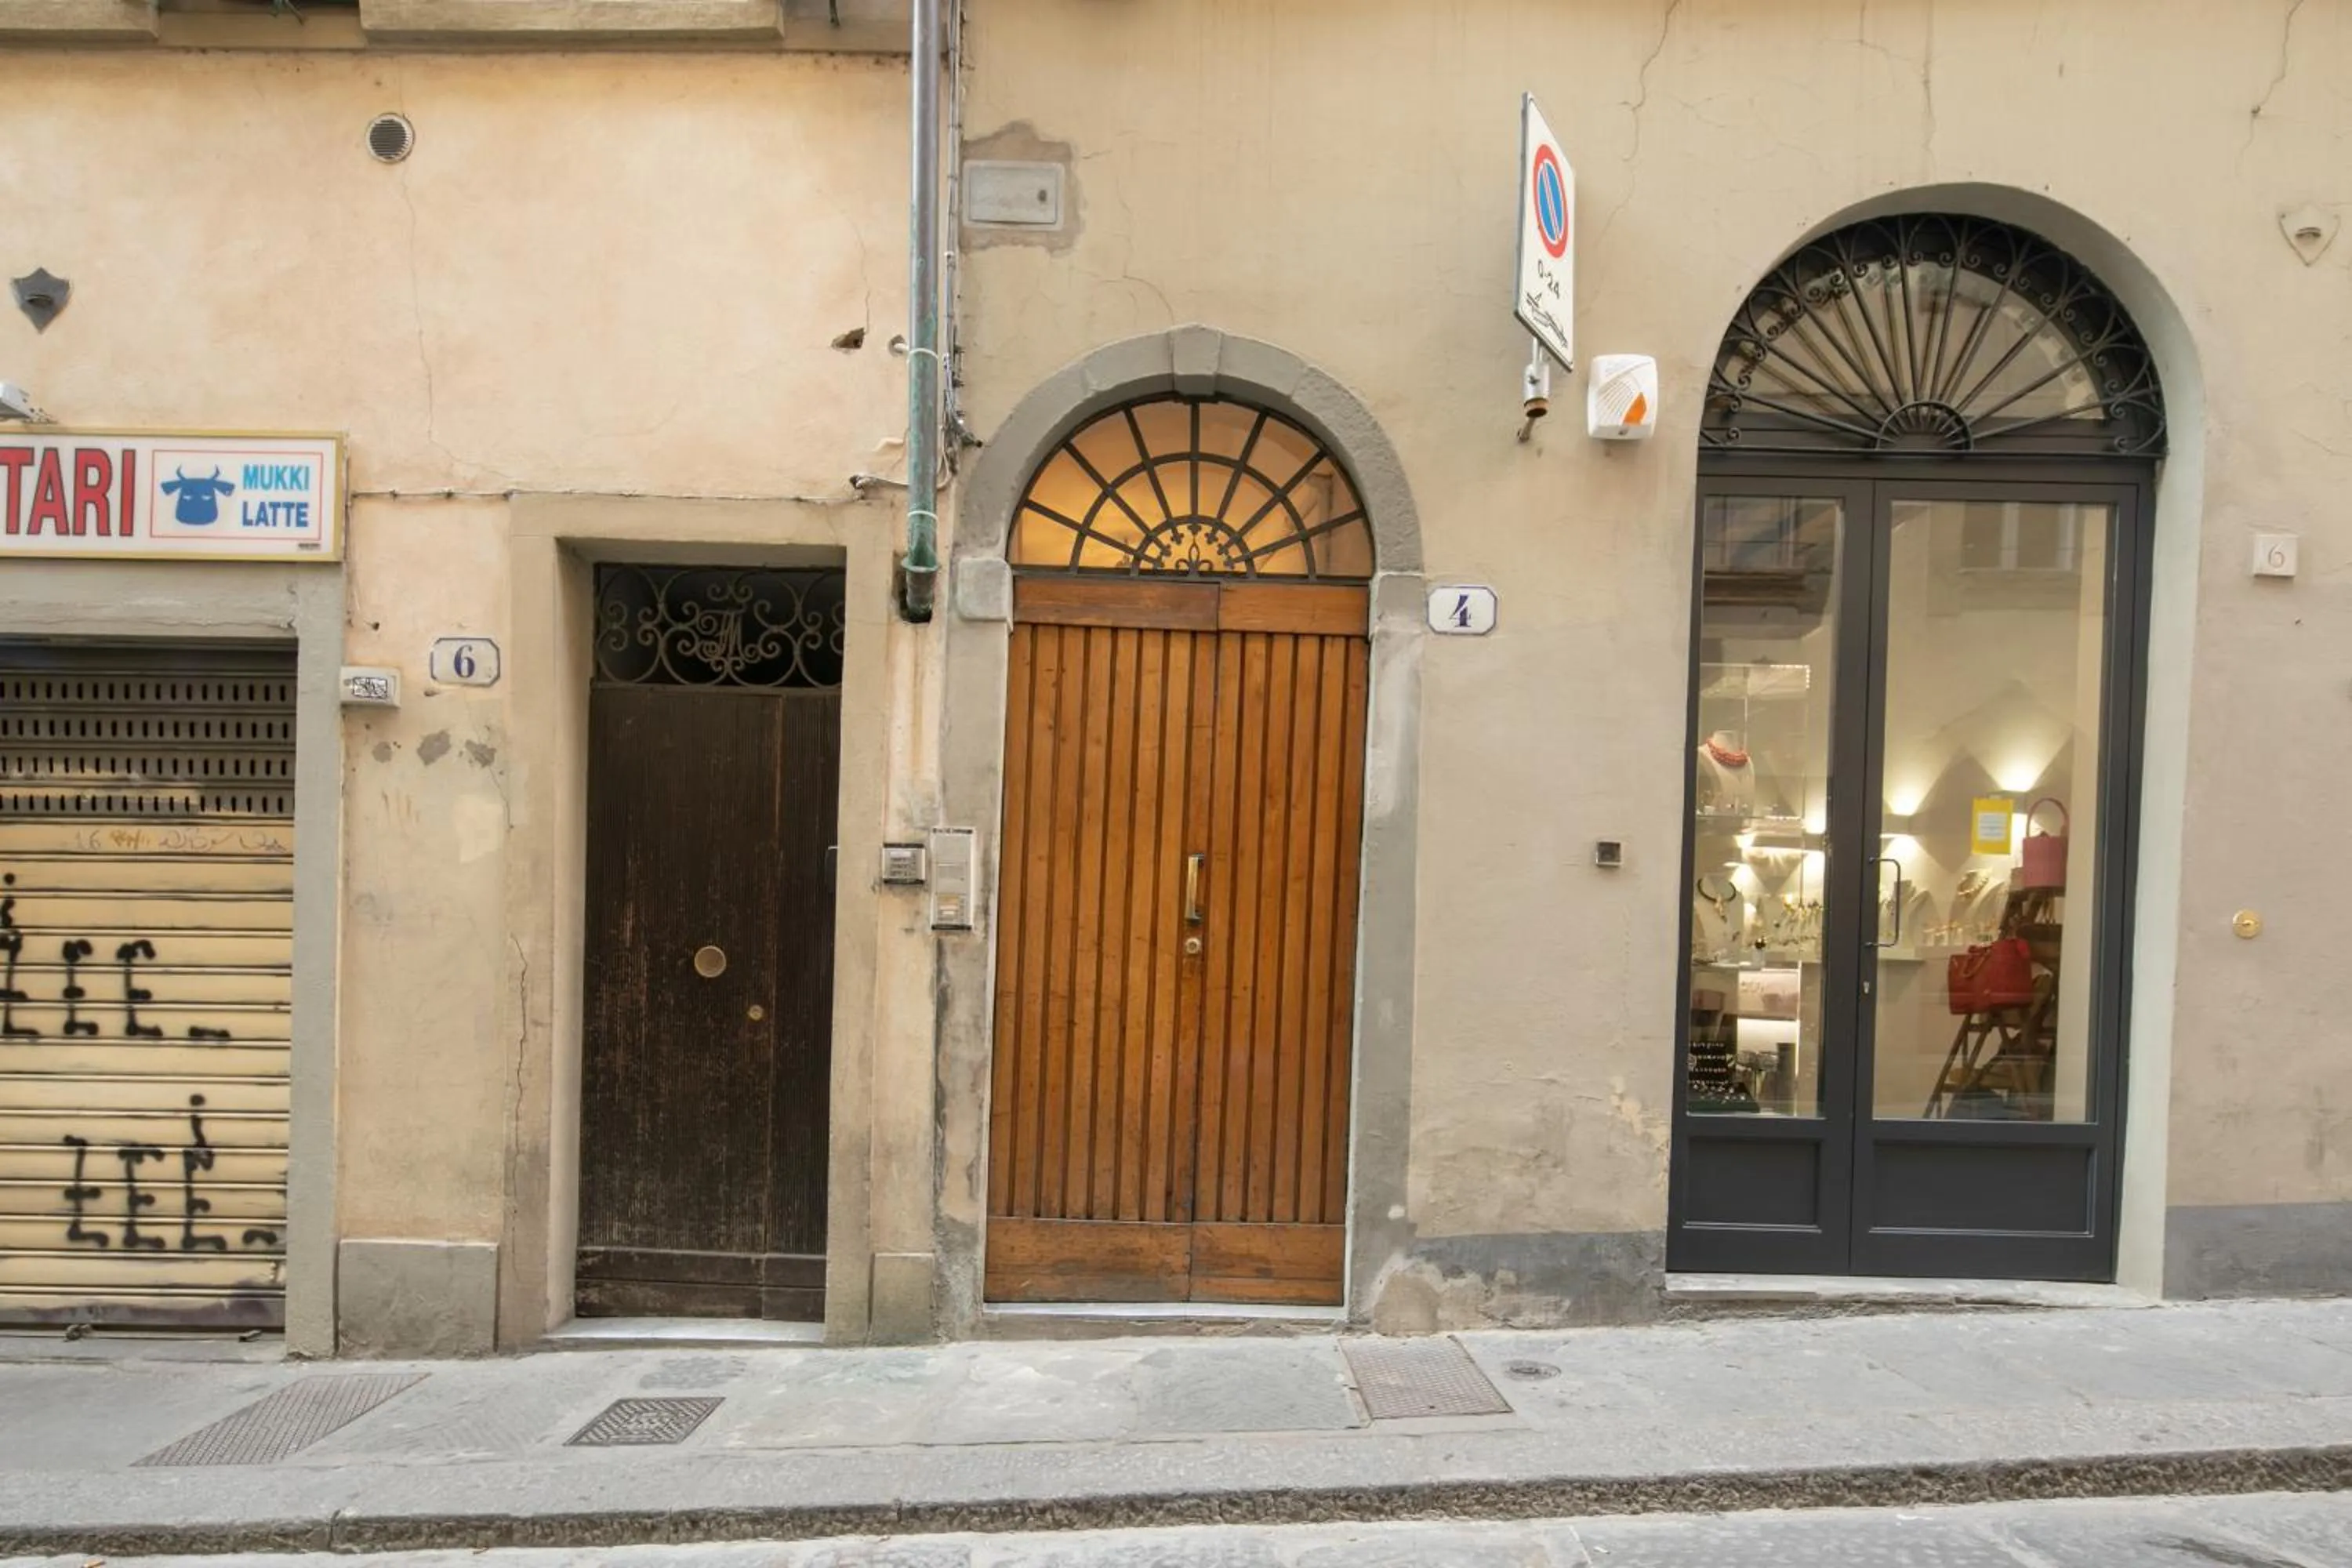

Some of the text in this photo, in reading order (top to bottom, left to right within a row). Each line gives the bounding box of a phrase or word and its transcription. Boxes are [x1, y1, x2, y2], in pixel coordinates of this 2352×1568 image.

[0, 447, 136, 537] TARI
[242, 463, 310, 491] MUKKI
[241, 501, 310, 528] LATTE
[2267, 541, 2286, 569] 6
[1448, 593, 1472, 628] 4
[453, 644, 475, 678] 6
